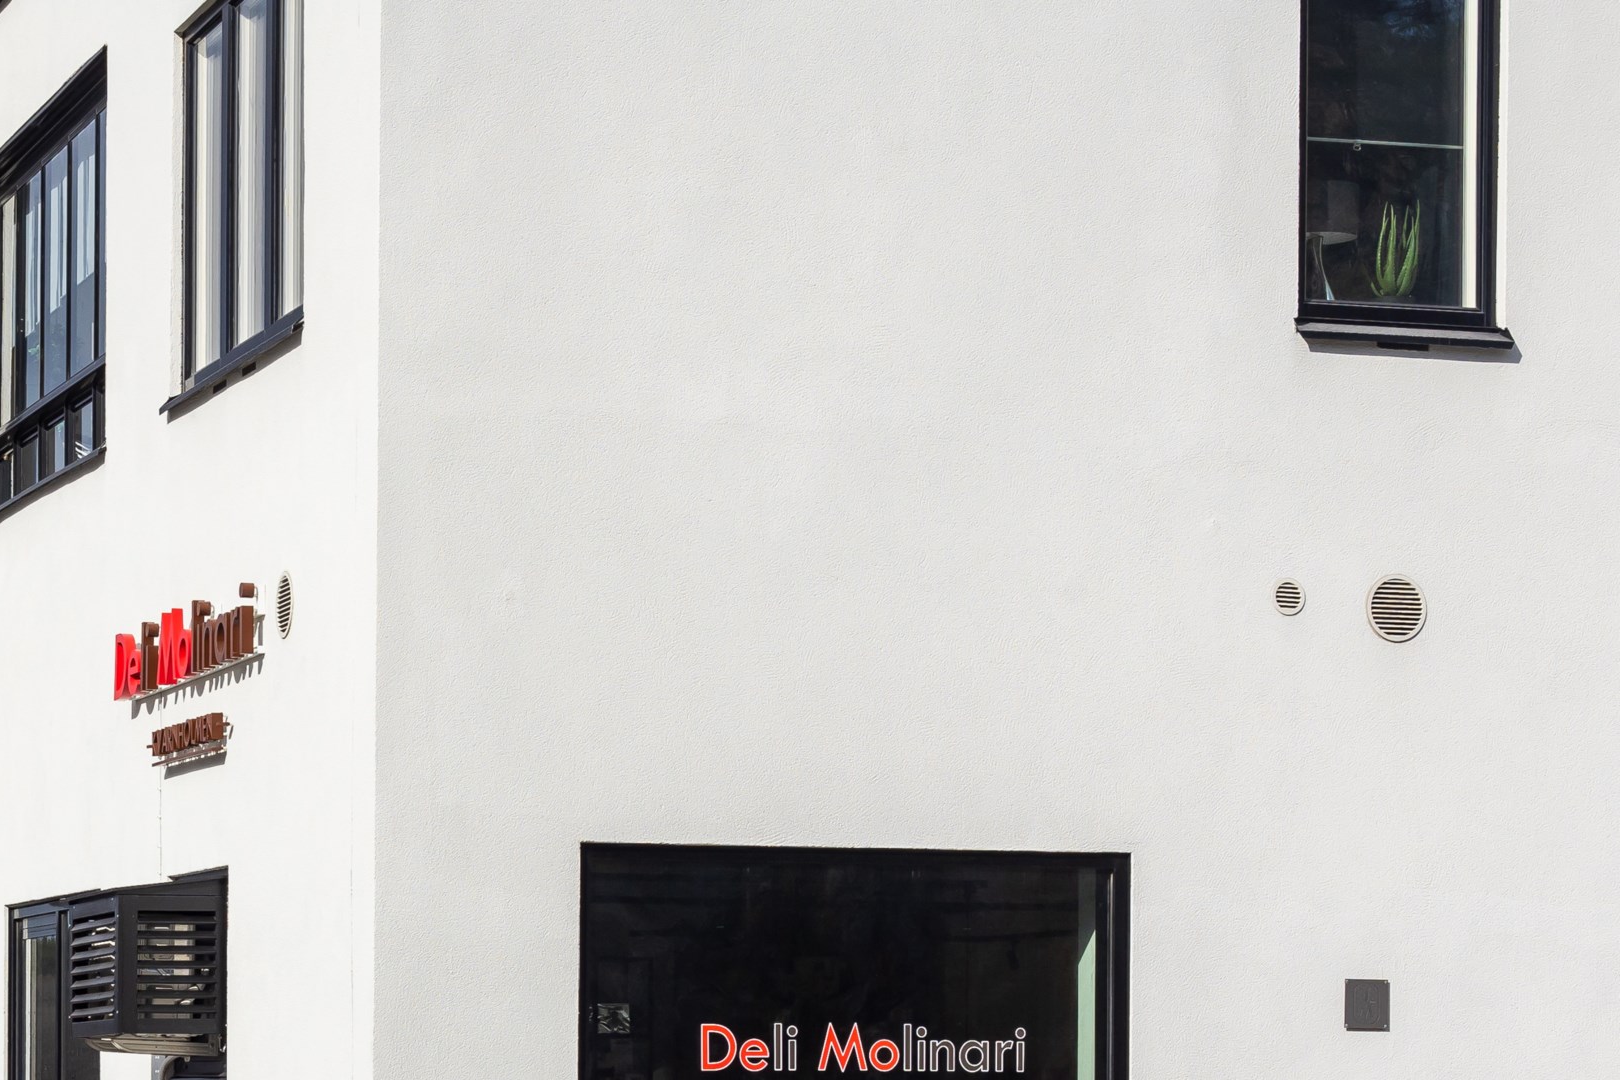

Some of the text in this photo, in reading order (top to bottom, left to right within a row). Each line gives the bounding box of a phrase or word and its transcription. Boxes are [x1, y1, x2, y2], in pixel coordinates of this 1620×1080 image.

[113, 582, 255, 702] Deli Molinari
[700, 1021, 1027, 1073] Deli Molinari
